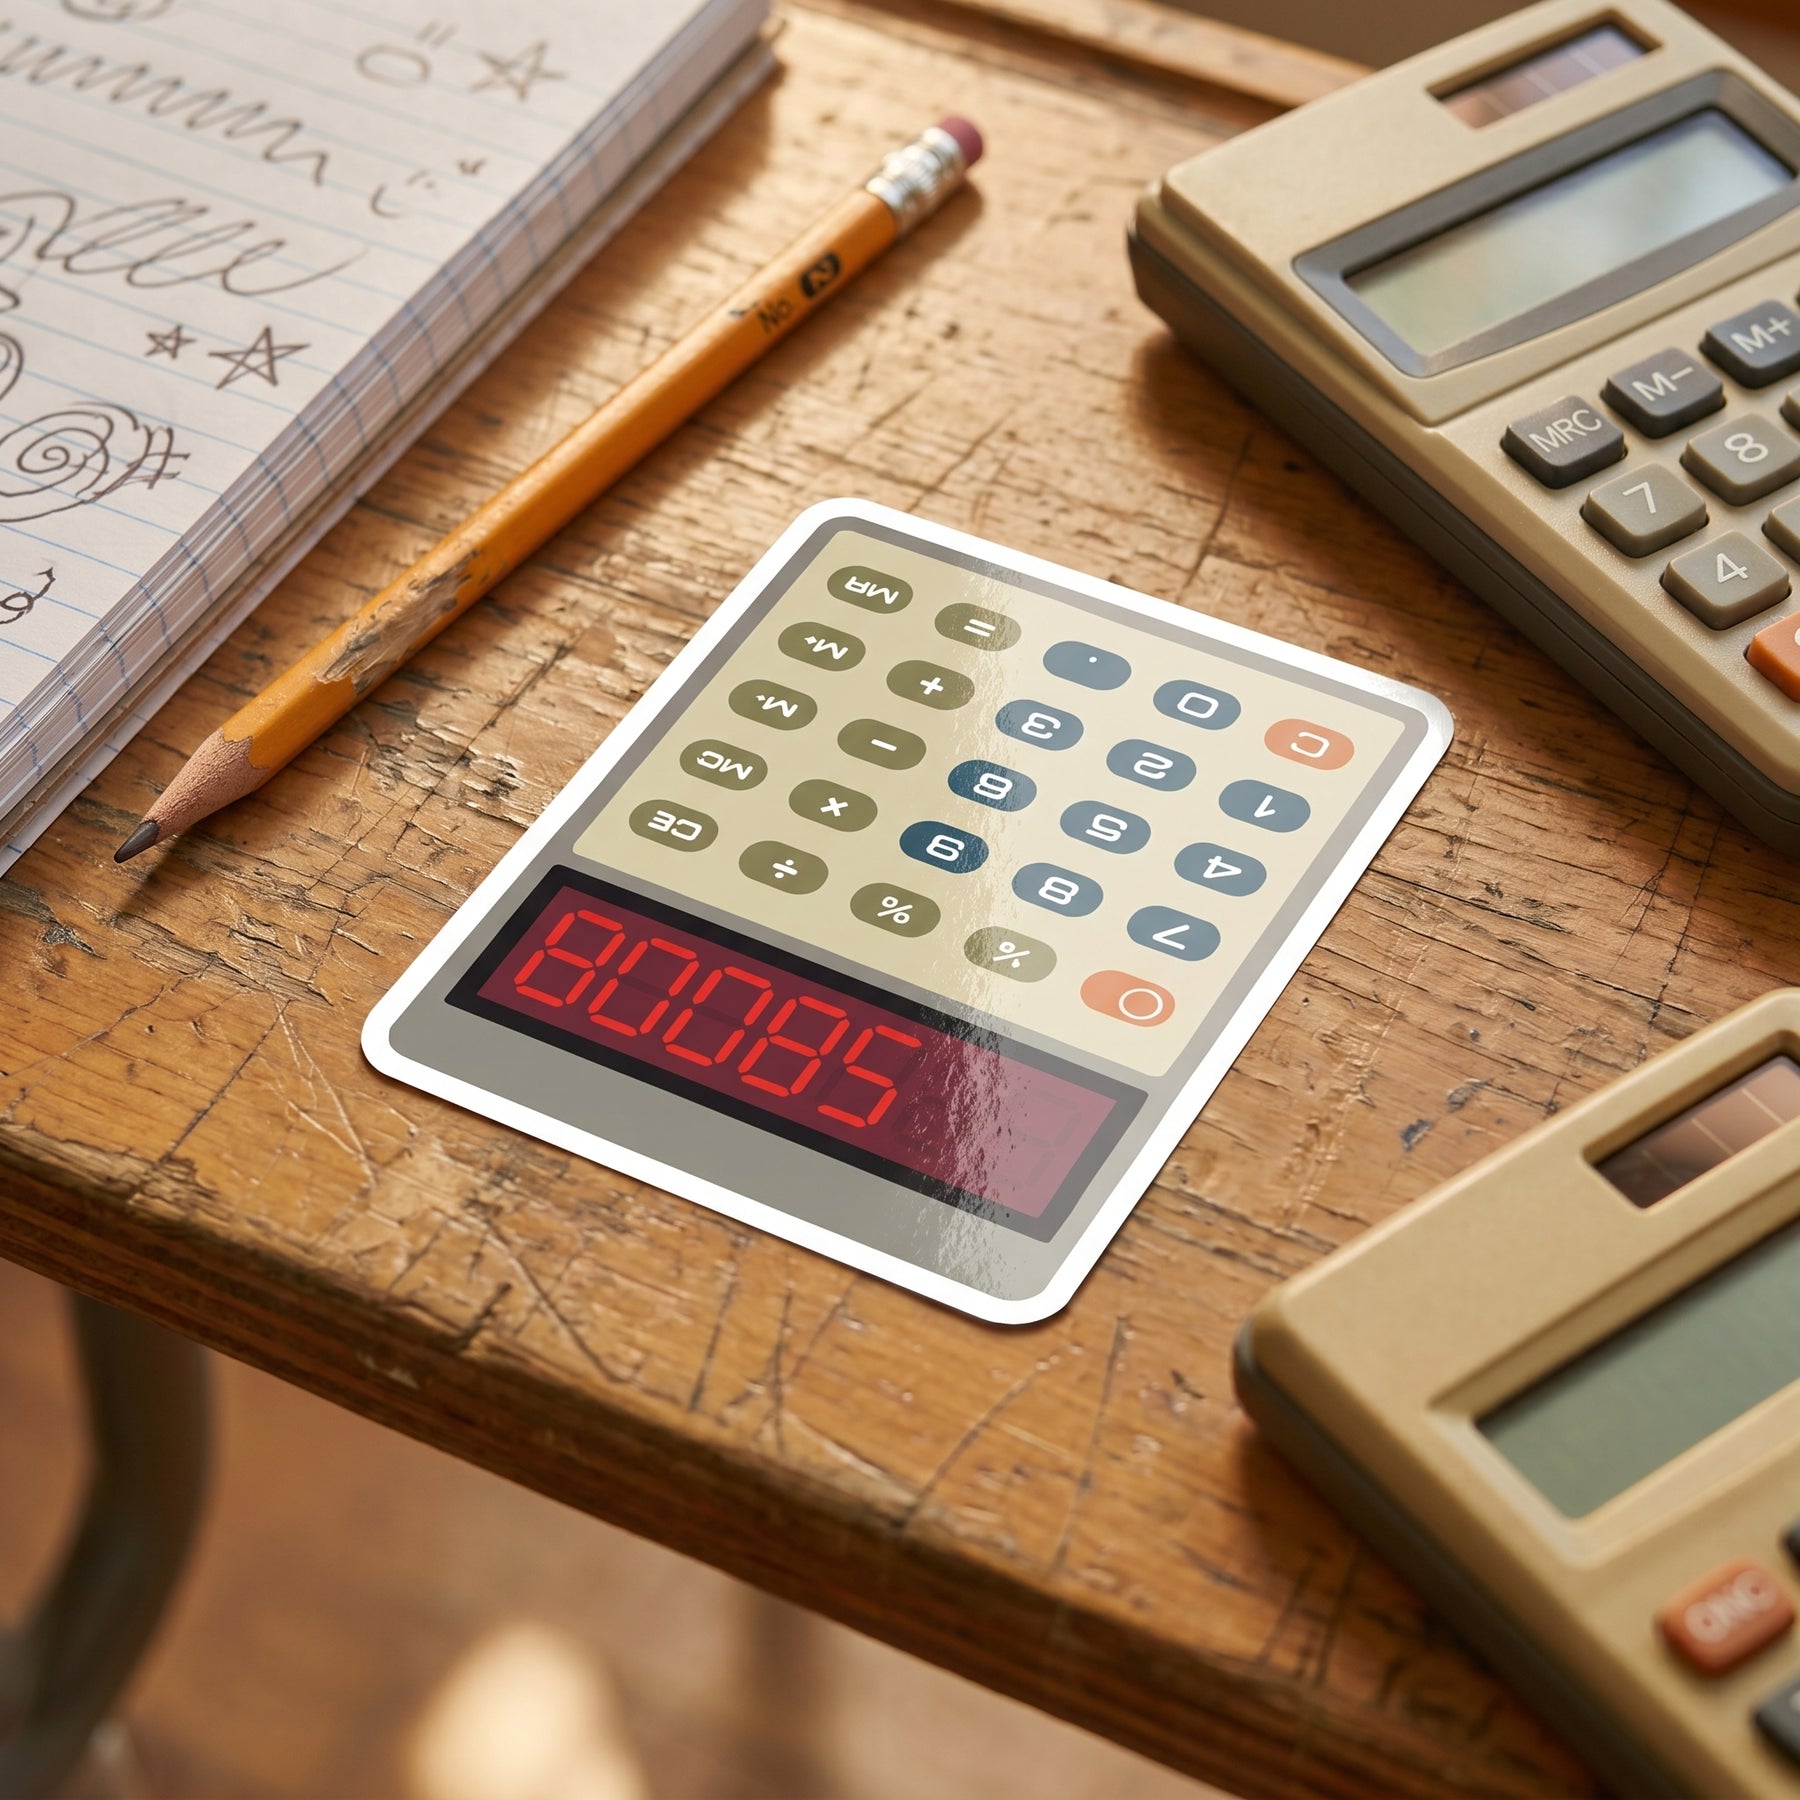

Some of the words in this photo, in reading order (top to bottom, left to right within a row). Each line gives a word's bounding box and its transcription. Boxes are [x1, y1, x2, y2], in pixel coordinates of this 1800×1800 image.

[1731, 316, 1793, 355] M+
[1529, 408, 1602, 454] MRC
[1723, 432, 1769, 464] 8
[1622, 481, 1658, 515] 7
[1716, 553, 1749, 584] 4
[1021, 711, 1061, 740] 3
[1291, 732, 1329, 758] C
[696, 750, 753, 780] MC
[1133, 752, 1173, 780] 2
[1254, 795, 1276, 818] 1
[647, 810, 702, 841] CE
[1086, 814, 1128, 842] 5
[1203, 855, 1243, 879] 4
[1038, 876, 1080, 905] 8
[1152, 924, 1190, 951] 7
